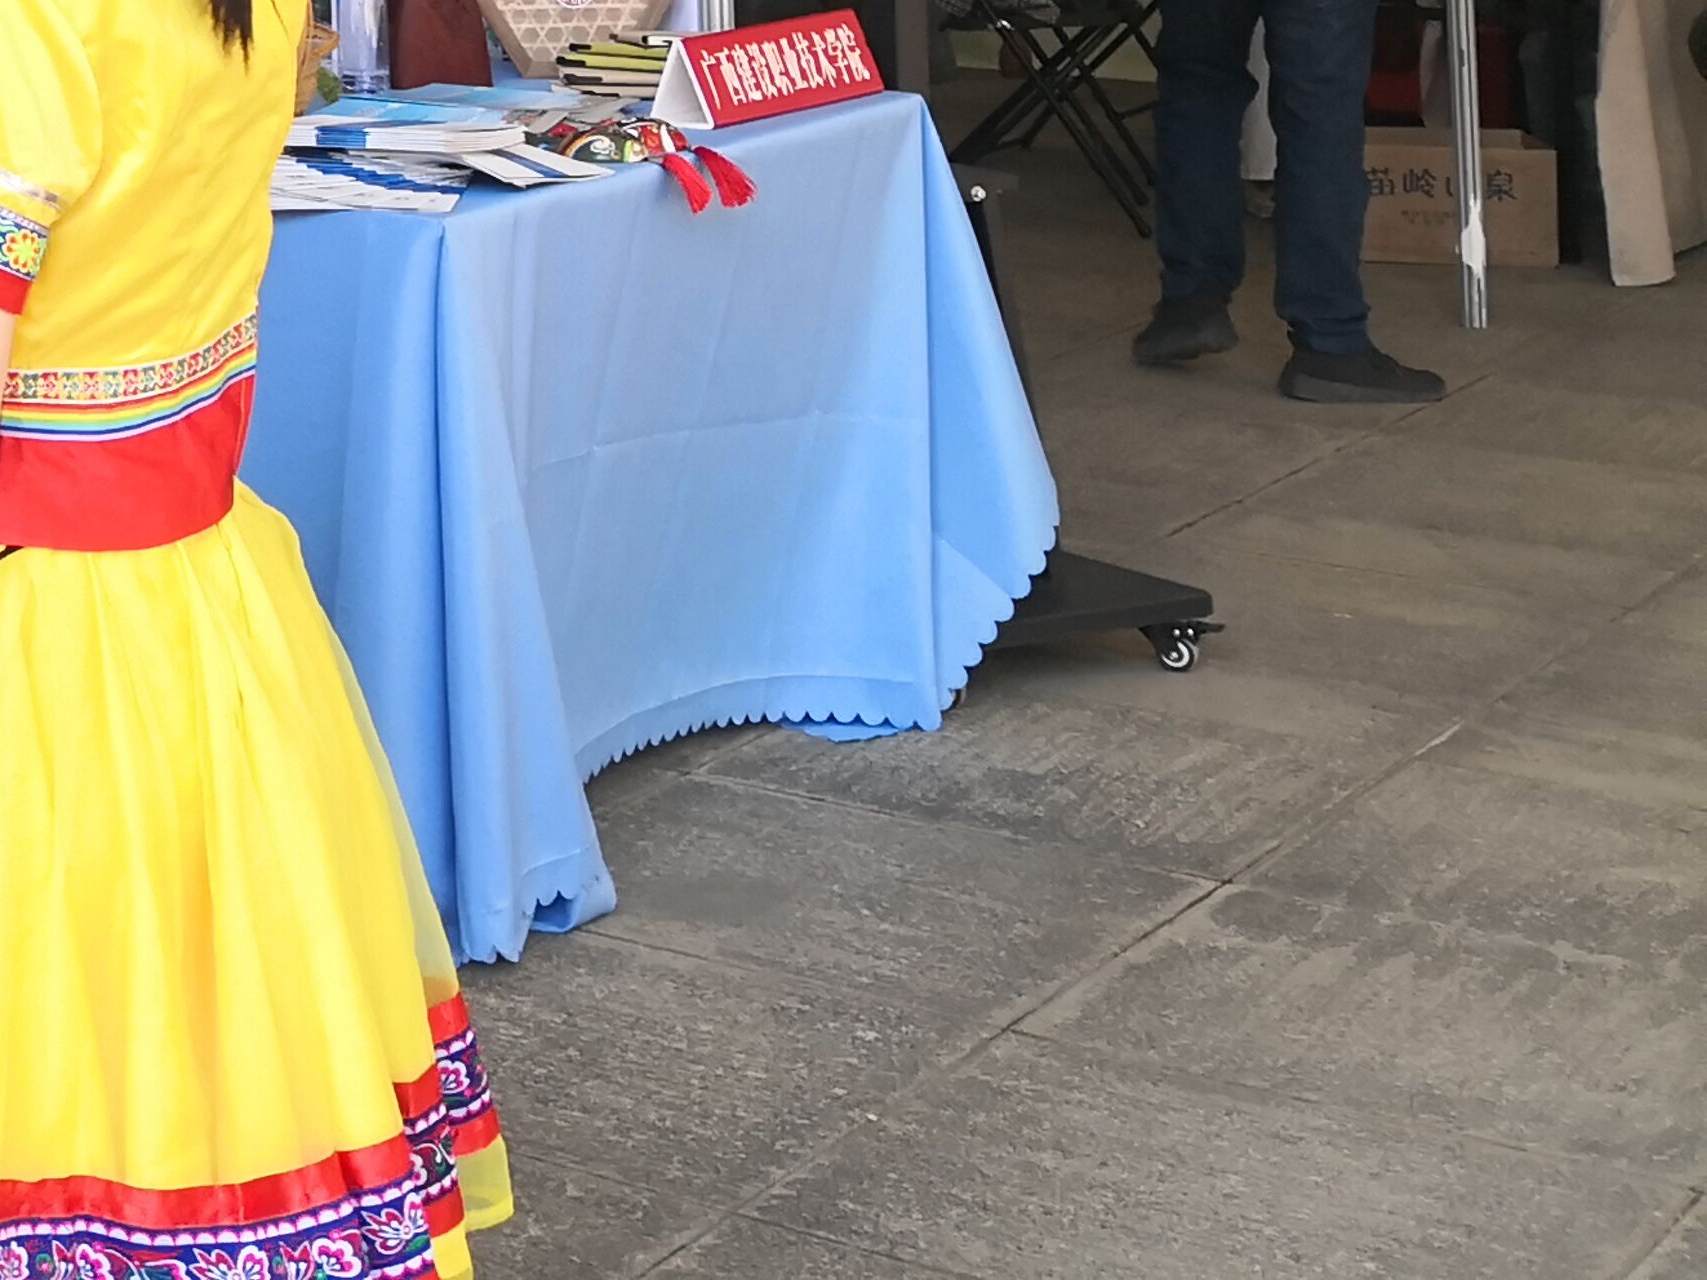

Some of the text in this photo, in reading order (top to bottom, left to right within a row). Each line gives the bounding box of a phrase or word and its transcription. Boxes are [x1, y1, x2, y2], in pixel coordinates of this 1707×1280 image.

[700, 23, 871, 111] 广西建设职业技术学院
